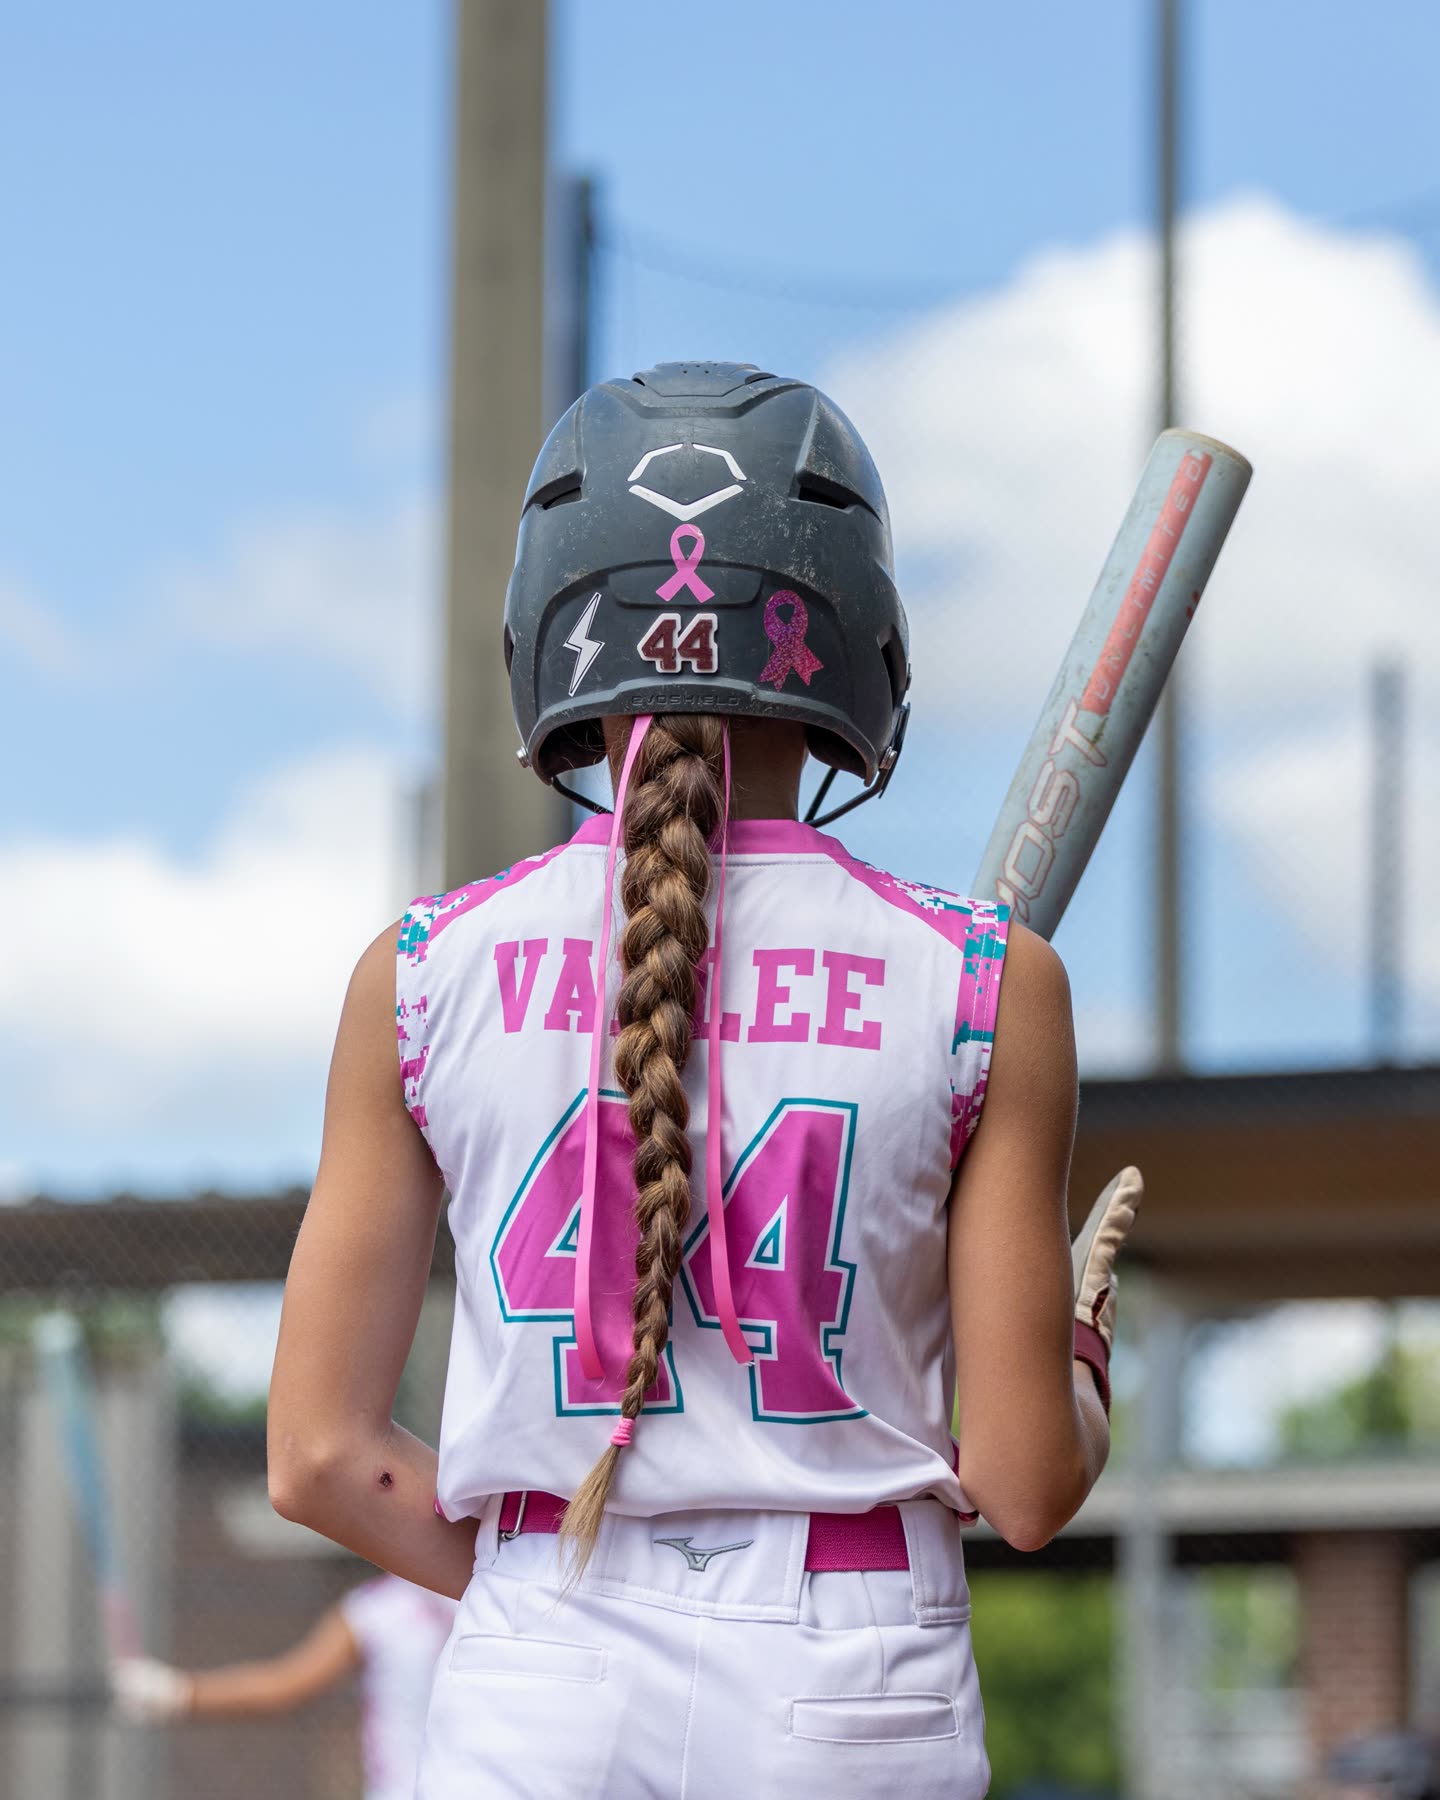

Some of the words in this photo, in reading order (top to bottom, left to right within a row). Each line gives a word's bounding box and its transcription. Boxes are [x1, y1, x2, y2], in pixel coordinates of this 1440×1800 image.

[637, 613, 718, 673] 44
[1092, 458, 1203, 701] UNLIMITED
[493, 938, 886, 1051] VALEE
[490, 1088, 870, 1424] 44
